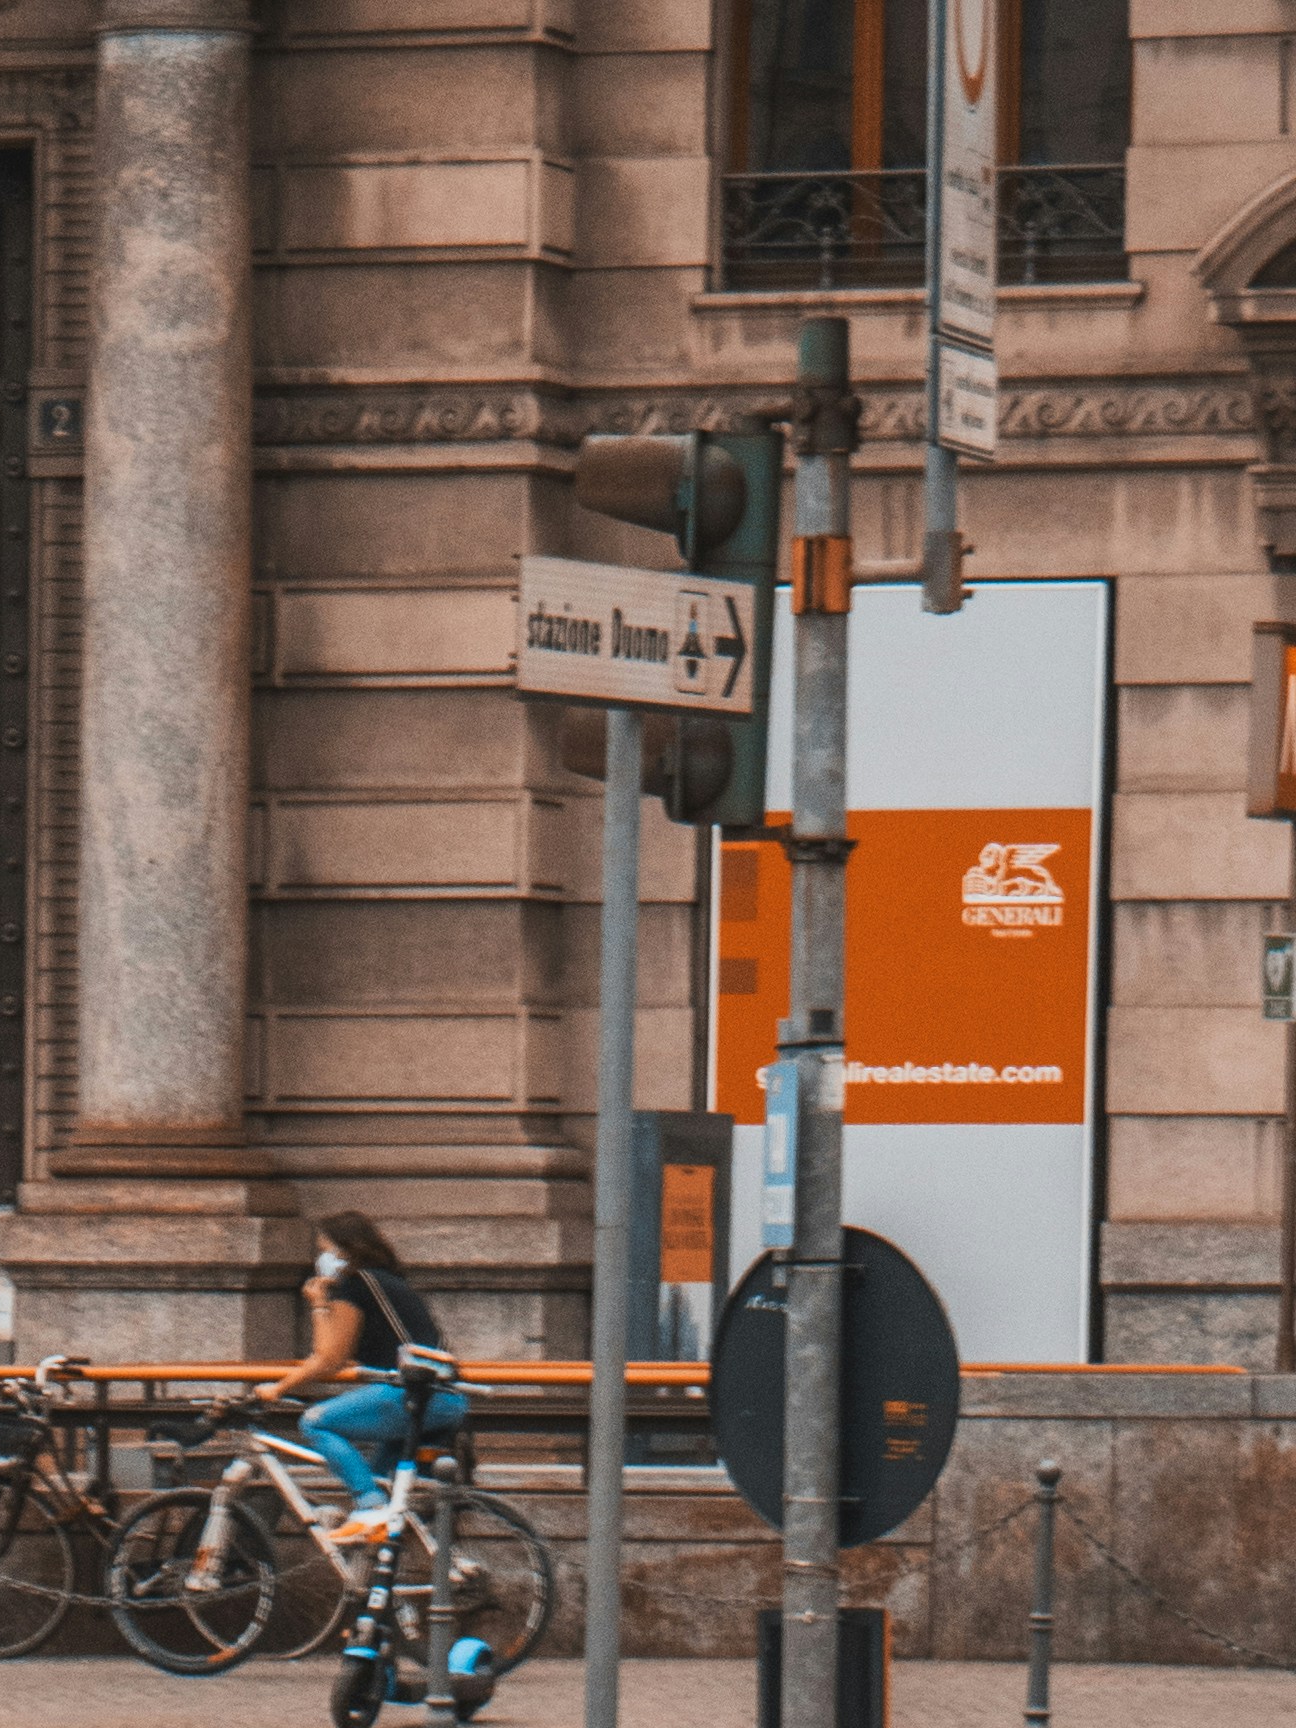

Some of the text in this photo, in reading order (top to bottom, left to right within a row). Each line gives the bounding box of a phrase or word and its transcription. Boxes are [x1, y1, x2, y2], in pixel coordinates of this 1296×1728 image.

[527, 601, 669, 663] stazione Duomo
[961, 905, 1064, 926] GENERALI
